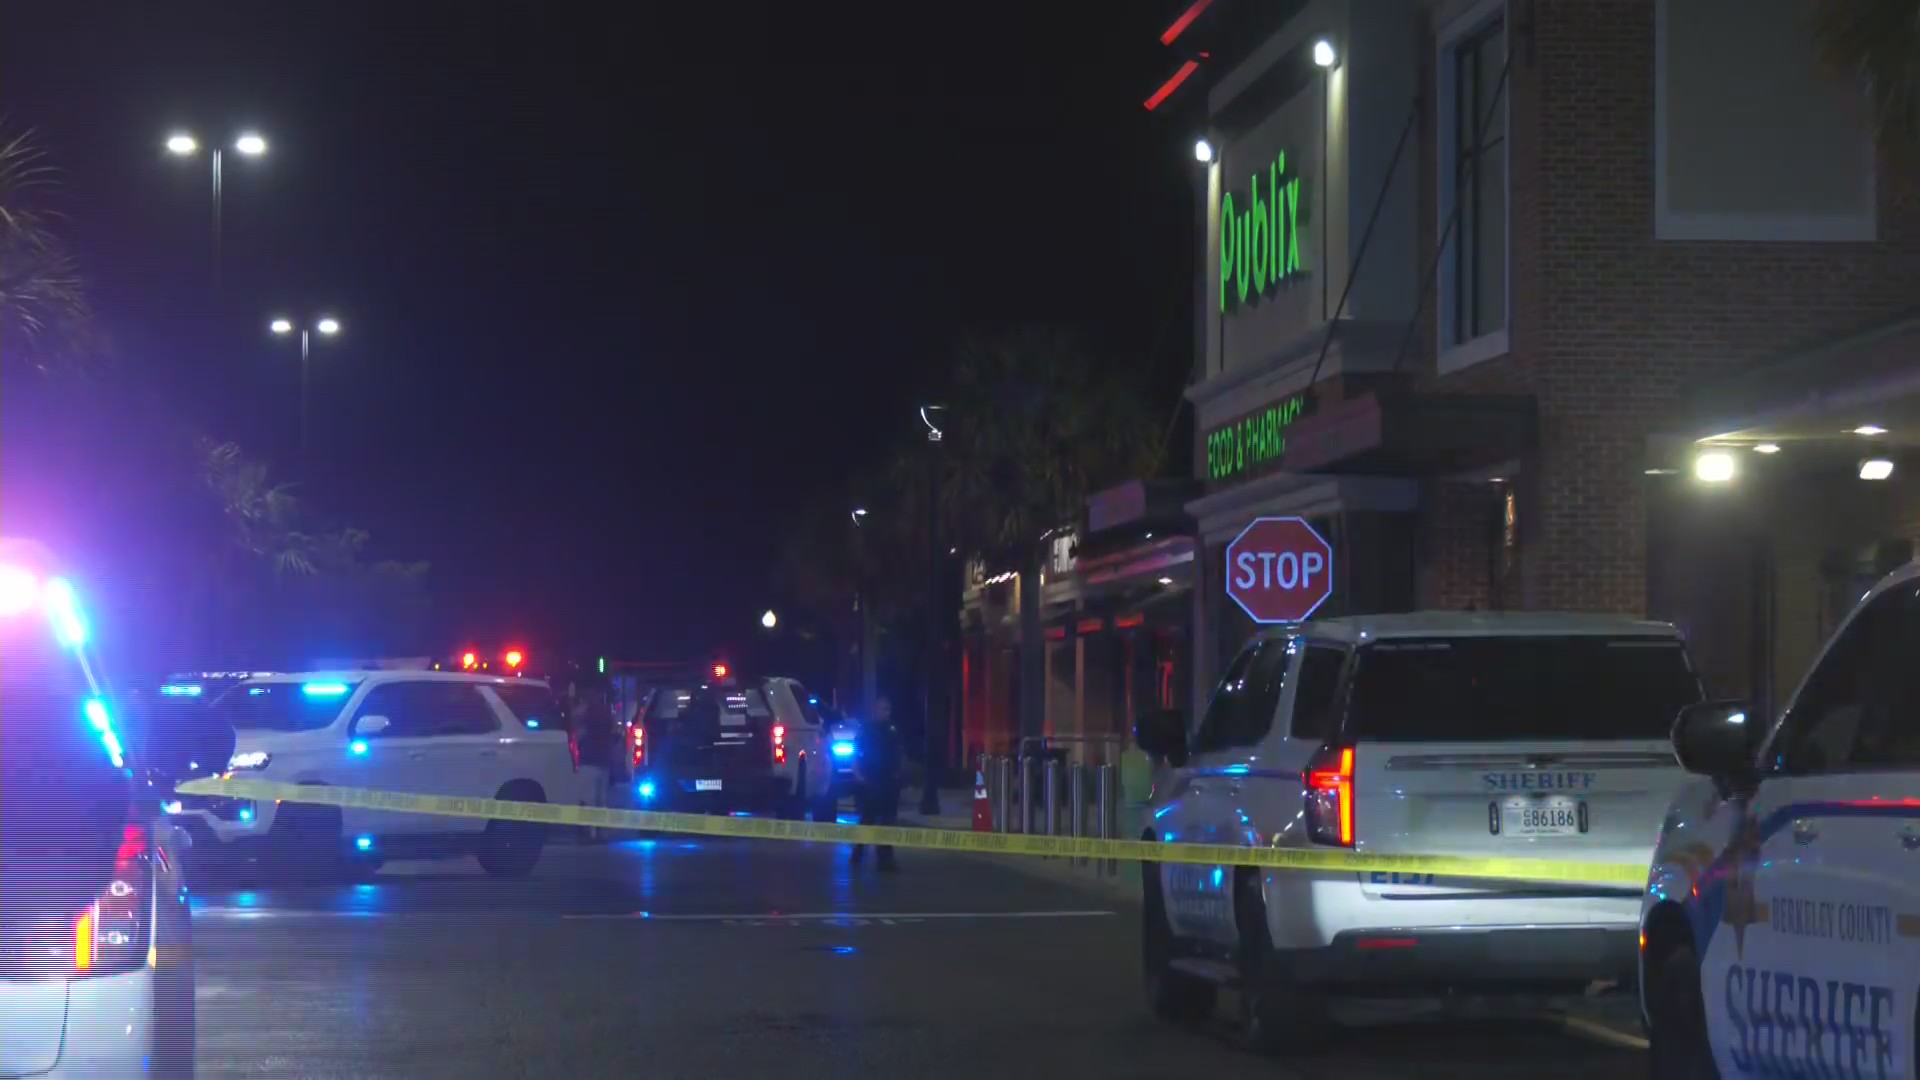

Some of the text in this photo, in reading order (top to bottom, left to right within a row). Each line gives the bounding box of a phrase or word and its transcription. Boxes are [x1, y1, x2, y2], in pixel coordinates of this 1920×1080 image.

[1220, 149, 1299, 313] Publix
[1207, 427, 1233, 479] FOOD
[1236, 422, 1243, 471] &
[1235, 551, 1323, 589] STOP
[1483, 771, 1597, 790] SHERIFF
[1531, 809, 1575, 827] 86186
[1772, 896, 1893, 944] BERKELEY COUNTY
[1725, 963, 1893, 1080] SHERIFF
